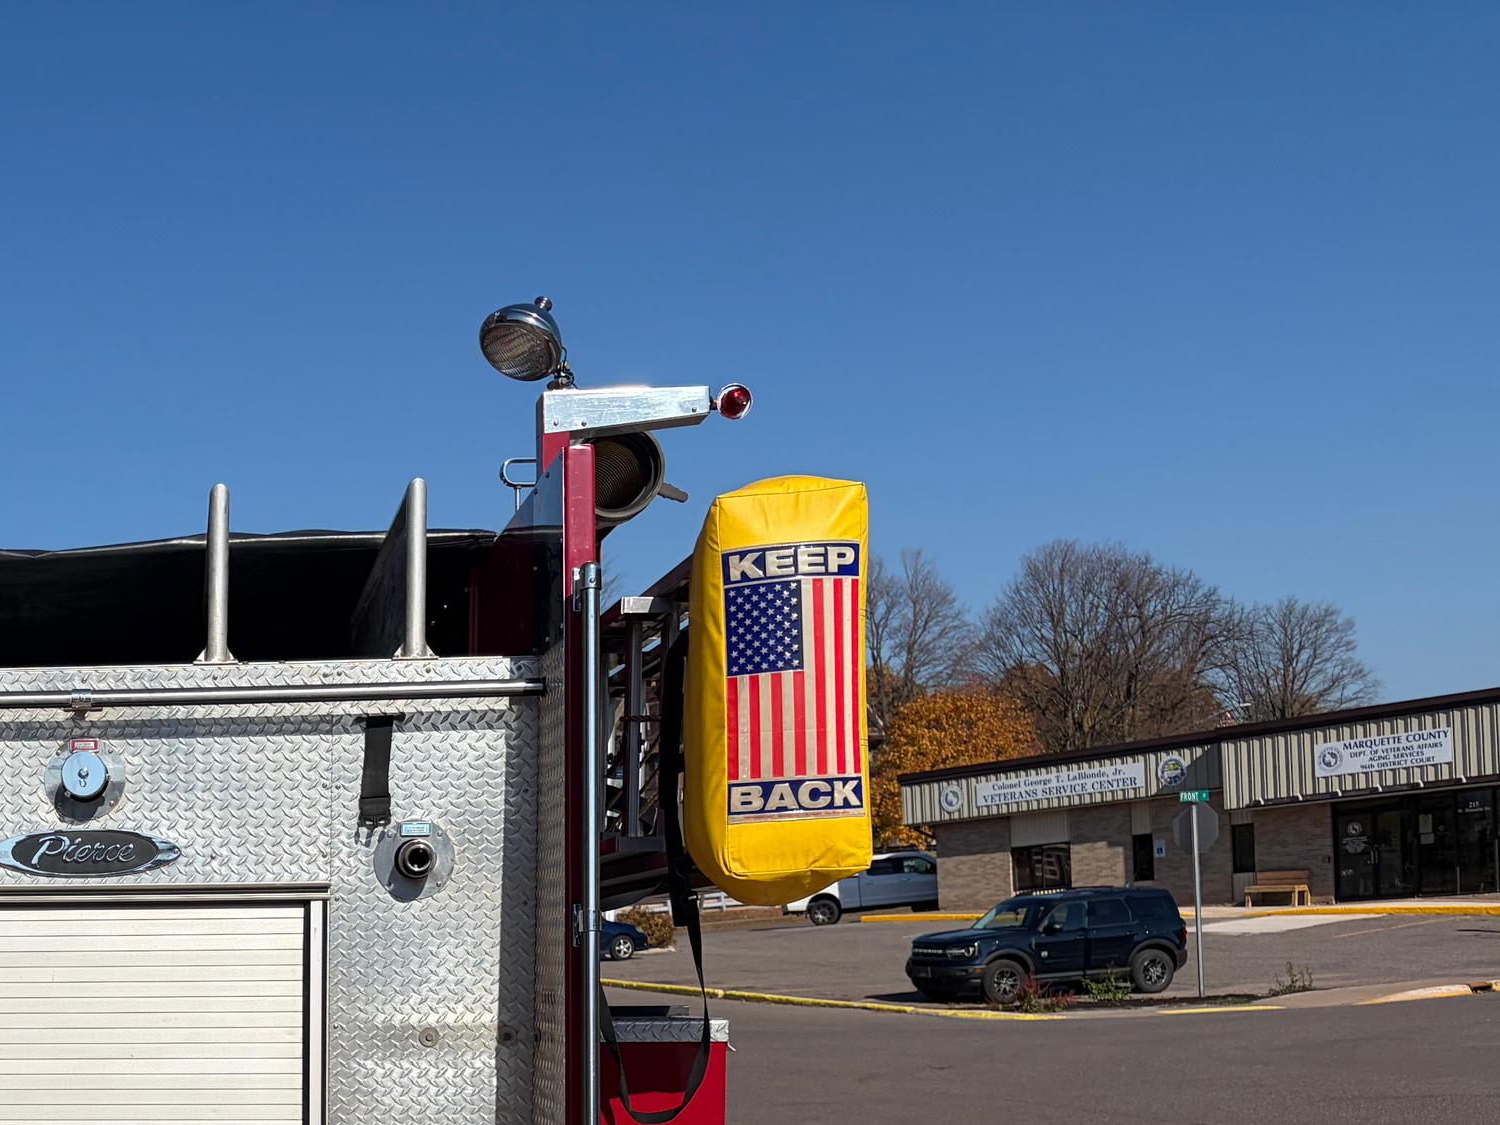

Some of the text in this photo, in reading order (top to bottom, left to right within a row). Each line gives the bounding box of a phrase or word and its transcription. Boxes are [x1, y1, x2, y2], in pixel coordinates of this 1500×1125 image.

[728, 545, 856, 582] KEEP
[1343, 730, 1449, 750] MARQUETTE COUNTY
[1381, 744, 1415, 755] VETERANS
[1417, 741, 1443, 750] AFFAIRS
[1368, 750, 1425, 762] AGING SERVICES
[1377, 760, 1408, 769] DISTRICT
[1411, 756, 1436, 765] COURT
[983, 776, 1138, 803] VETERANS SERVICE CENTER
[992, 767, 1126, 792] Colonel George T. LaBlonde, Jr.
[730, 780, 862, 813] BACK
[1180, 791, 1199, 802] FRONT
[31, 835, 136, 868] Pierce
